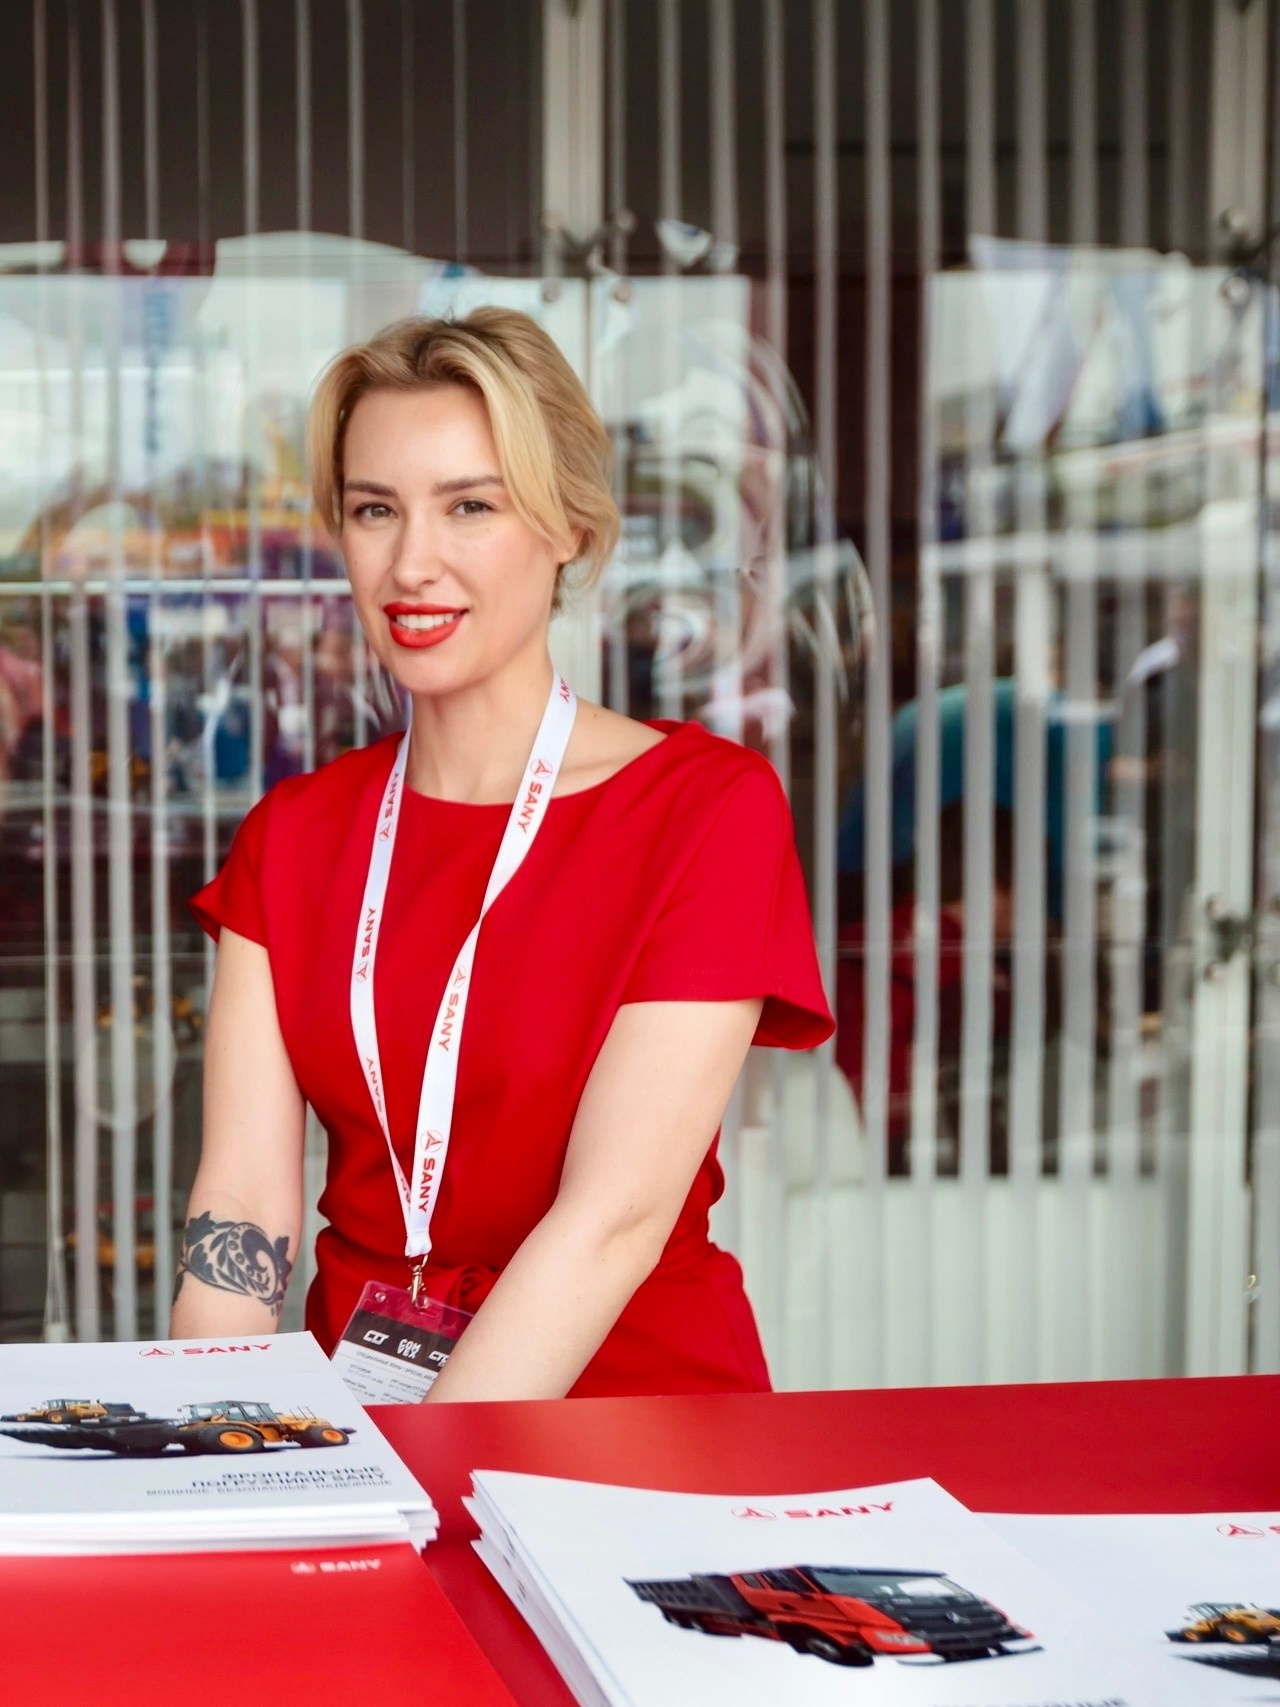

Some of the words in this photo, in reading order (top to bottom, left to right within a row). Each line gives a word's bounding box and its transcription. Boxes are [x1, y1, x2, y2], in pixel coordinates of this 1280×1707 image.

[384, 772, 399, 818] SANY
[518, 782, 542, 834] SANY
[362, 907, 376, 958] SANY
[439, 993, 459, 1052] SANY
[419, 1158, 436, 1212] SANY
[182, 1343, 273, 1355] SANY
[222, 1466, 382, 1479] ФРОНТАЛЬНЫЕ
[331, 1473, 385, 1481] SANY
[784, 1502, 893, 1519] SANY
